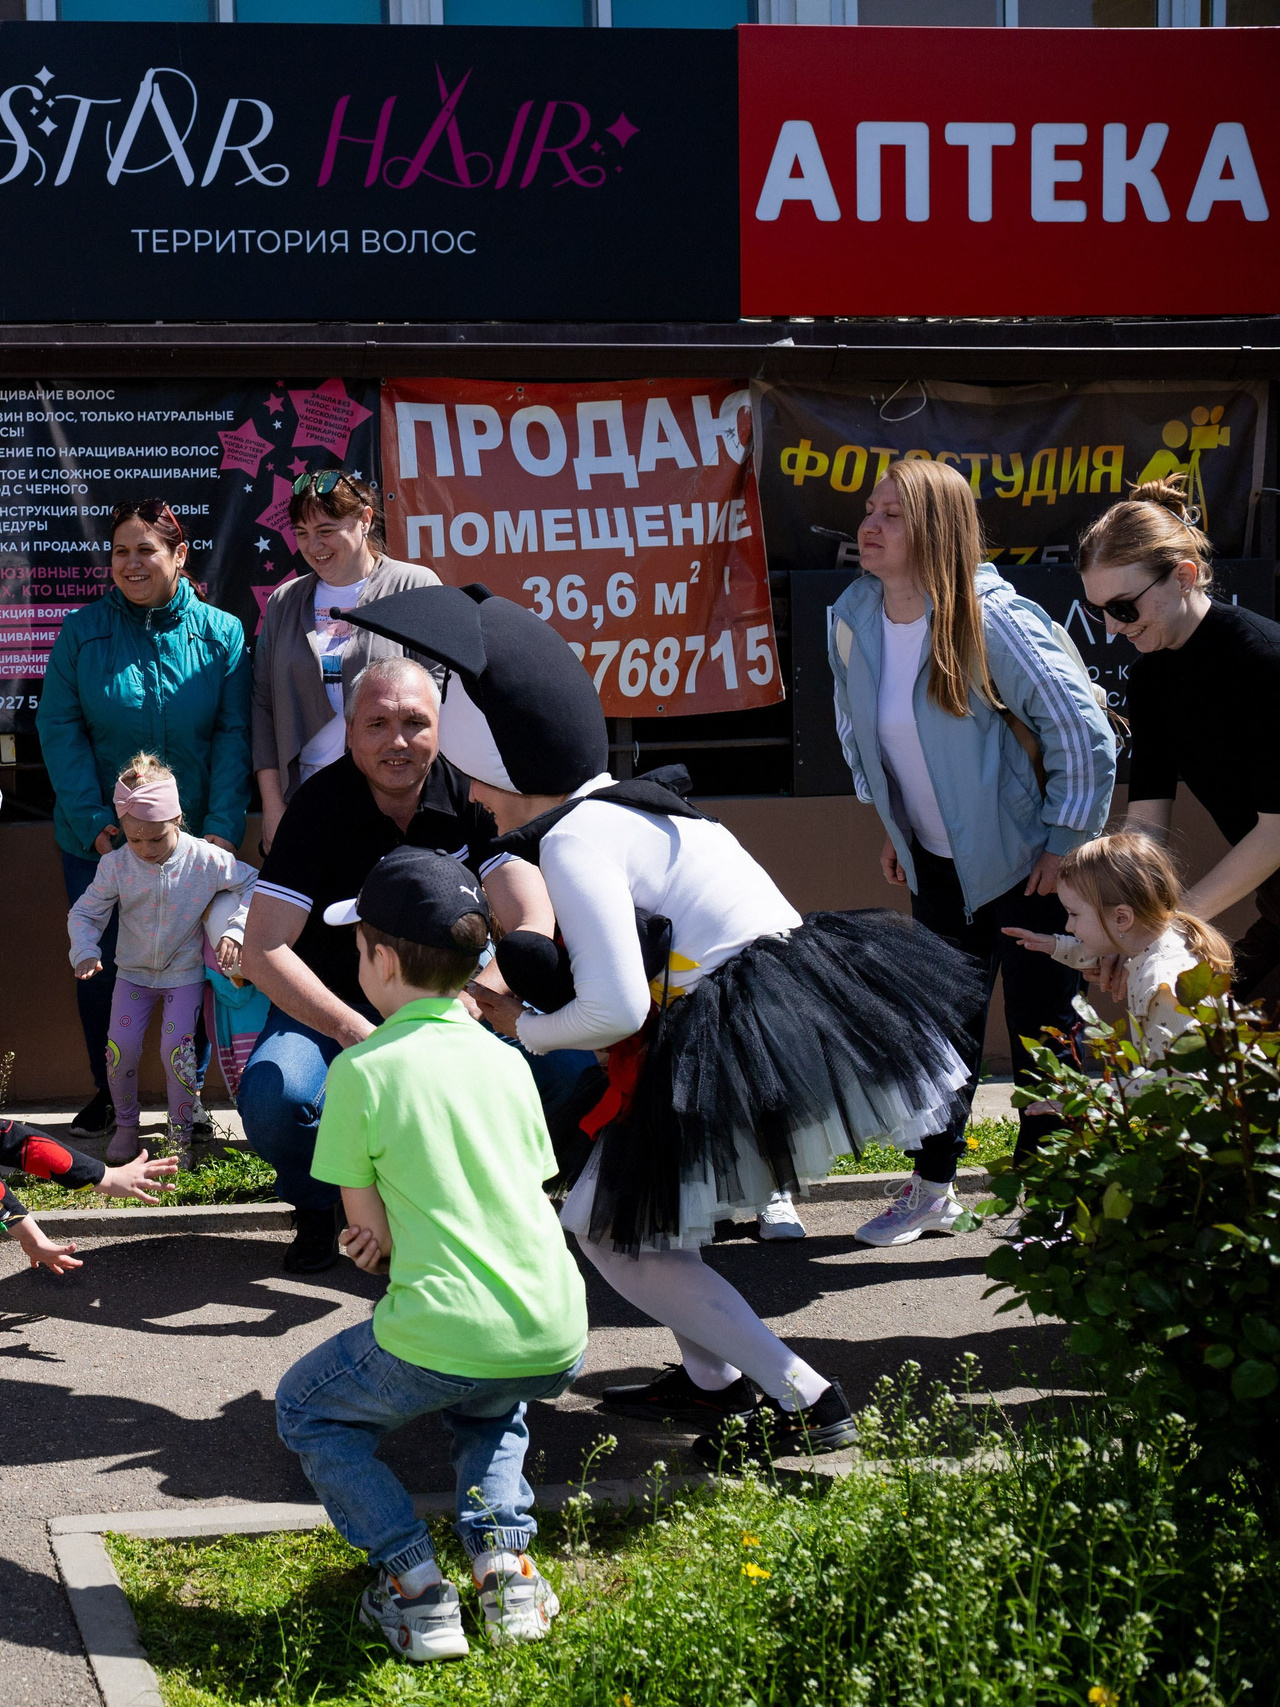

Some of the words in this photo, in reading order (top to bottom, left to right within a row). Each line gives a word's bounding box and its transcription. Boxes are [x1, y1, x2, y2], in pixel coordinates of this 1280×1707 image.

[318, 61, 606, 190] HAIR
[755, 120, 1270, 223] АПТЕКА
[131, 229, 349, 255] ТЕРРИТОРИЯ
[361, 229, 477, 255] ВОЛОС
[67, 389, 115, 400] ВОЛОС
[312, 392, 336, 404] ЗАШЛА
[338, 399, 351, 408] БЕЗ
[26, 412, 78, 423] ВОЛОС,
[80, 411, 134, 422] ТОЛЬКО
[137, 411, 234, 421] НАТУРАЛЬНЫЕ
[305, 407, 349, 423] НЕСКОЛЬКО
[332, 406, 354, 417] ЧЕРЕЗ
[299, 413, 323, 425] ЧАСОВ
[324, 420, 351, 433] ВЫШЛА
[305, 424, 347, 439] ШИКАРНОЙ
[224, 440, 243, 450] КОГДА
[395, 388, 753, 490] ПРОДАЮ
[37, 447, 56, 457] ПО
[59, 446, 168, 458] НАРАЩИВАНИЮ
[171, 446, 219, 456] ВОЛОС
[227, 448, 258, 459] ХОРОШИЙ
[29, 469, 38, 479] И
[41, 469, 111, 479] СЛОЖНОЕ
[114, 468, 221, 479] ОКРАШИВАНИЕ,
[13, 484, 23, 495] С
[25, 484, 88, 495] ЧЕРНОГО
[169, 504, 210, 515] ОВЫЕ
[406, 499, 753, 558] ПОМЕЩЕНИЕ
[21, 542, 30, 552] И
[33, 541, 100, 553] ПРОДАЖА
[192, 540, 213, 550] СМ
[83, 566, 113, 578] УСЛ
[22, 584, 52, 596] КТО
[56, 584, 106, 598] ЦЕНИТ
[521, 571, 637, 630] 36,6
[37, 608, 70, 618] ВОЛО
[575, 624, 773, 697] 768715
